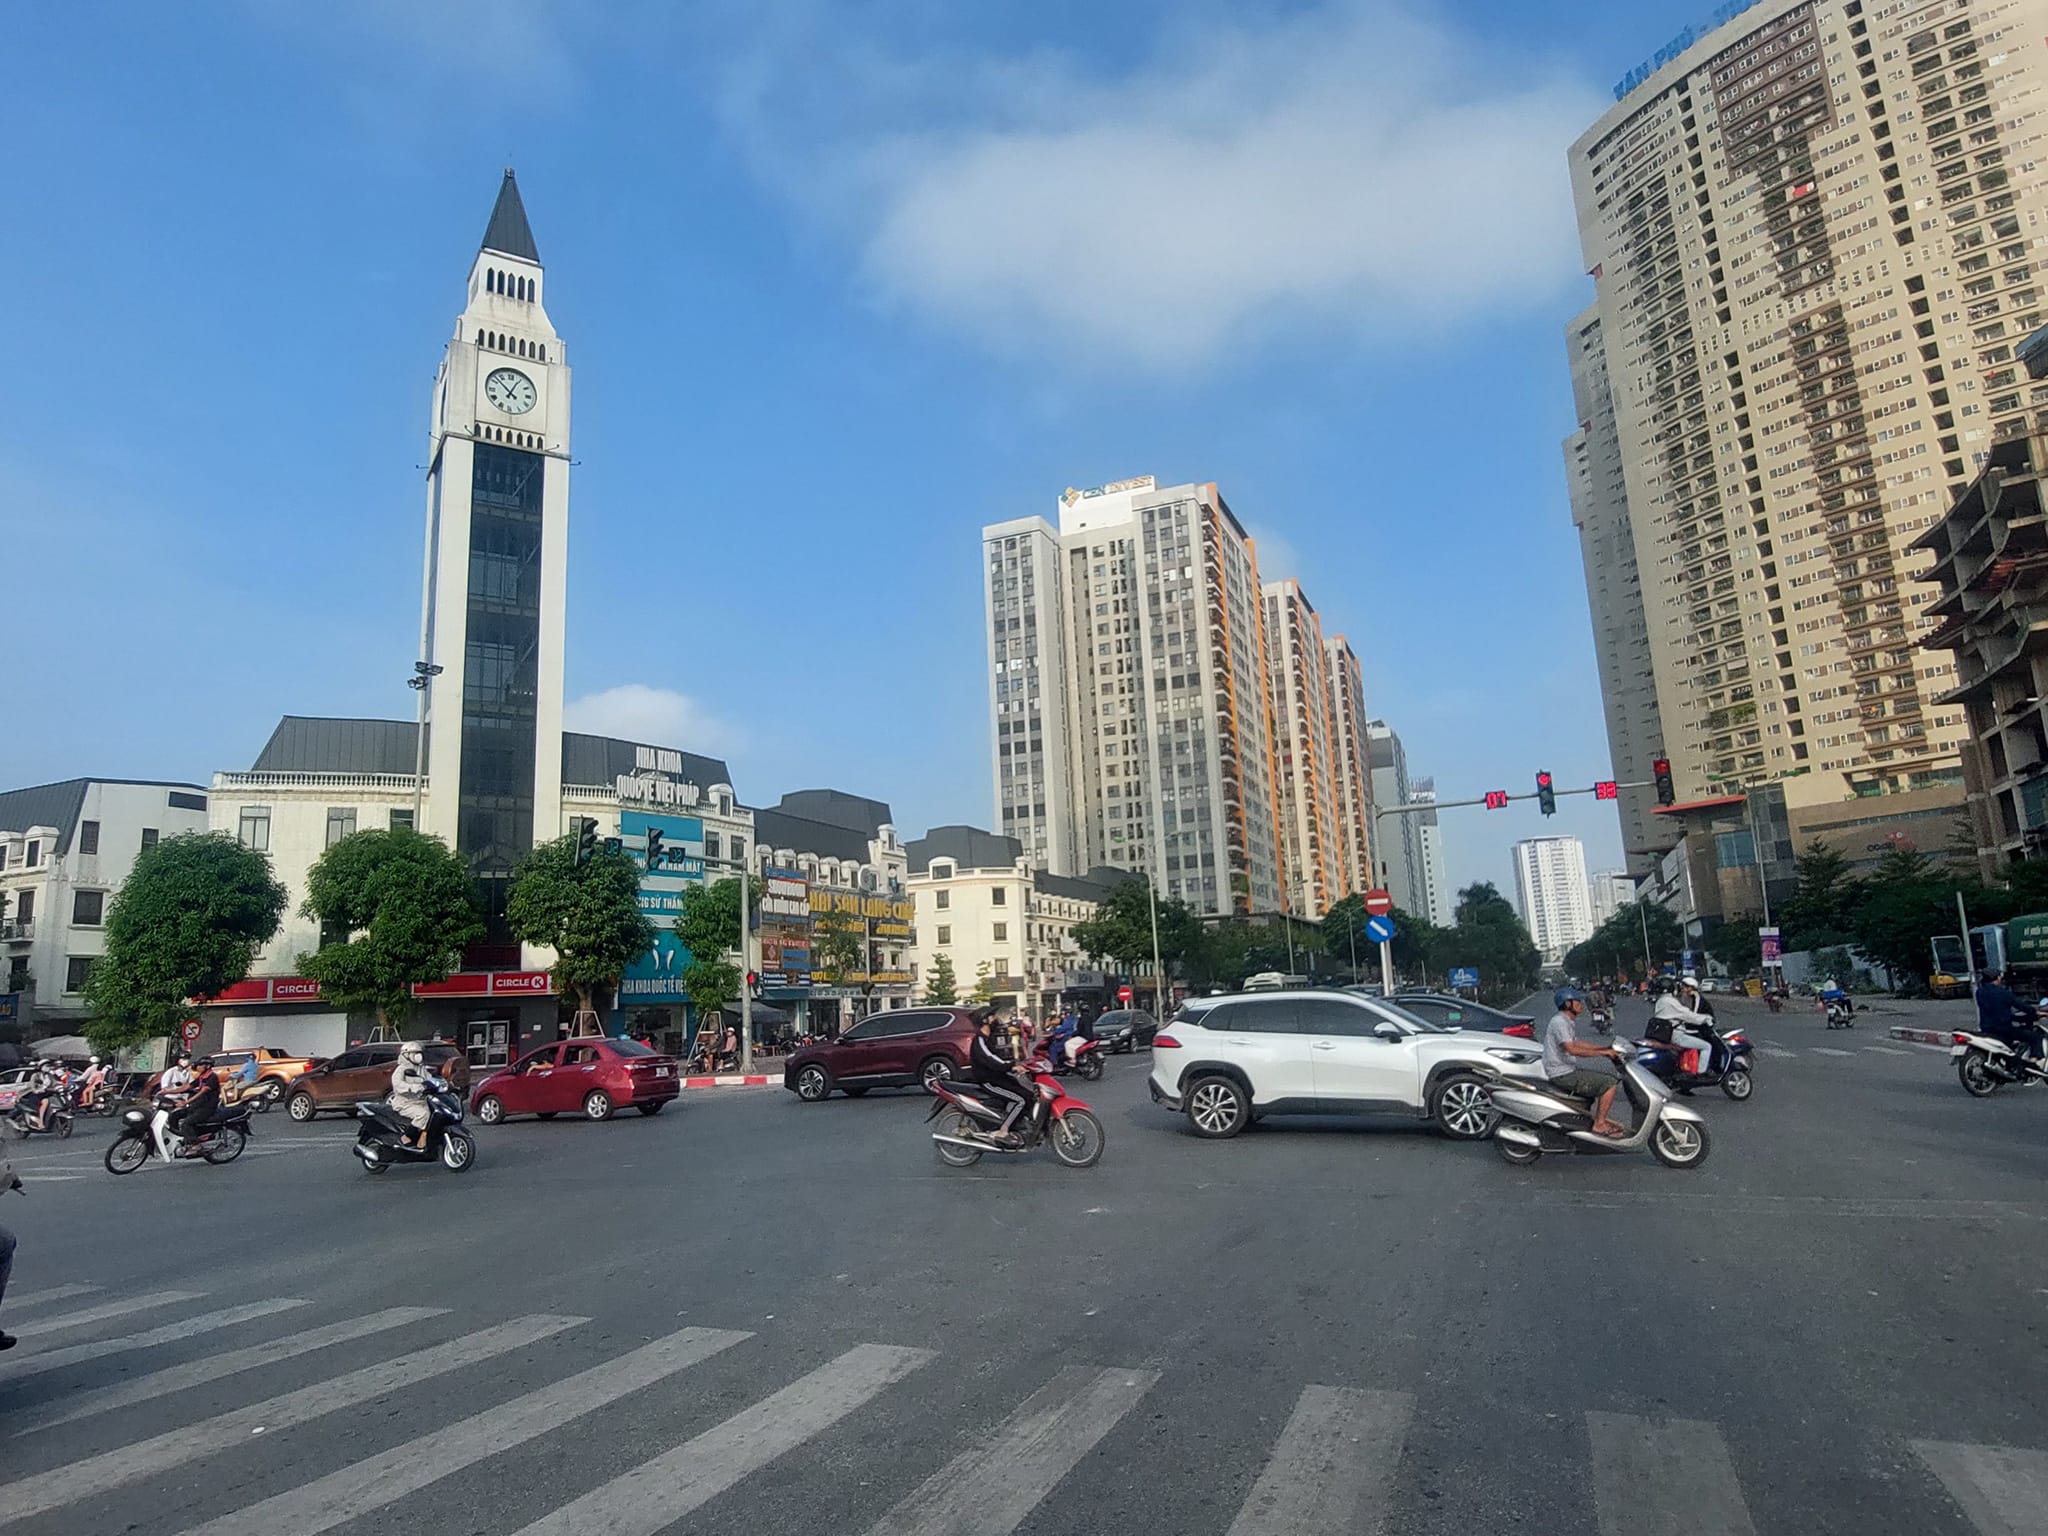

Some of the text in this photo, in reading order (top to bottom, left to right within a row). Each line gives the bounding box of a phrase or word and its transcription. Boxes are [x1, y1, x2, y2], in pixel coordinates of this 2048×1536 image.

[657, 749, 682, 774] KHOA
[496, 978, 530, 987] CIRCLE
[276, 984, 316, 994] CIRCLE
